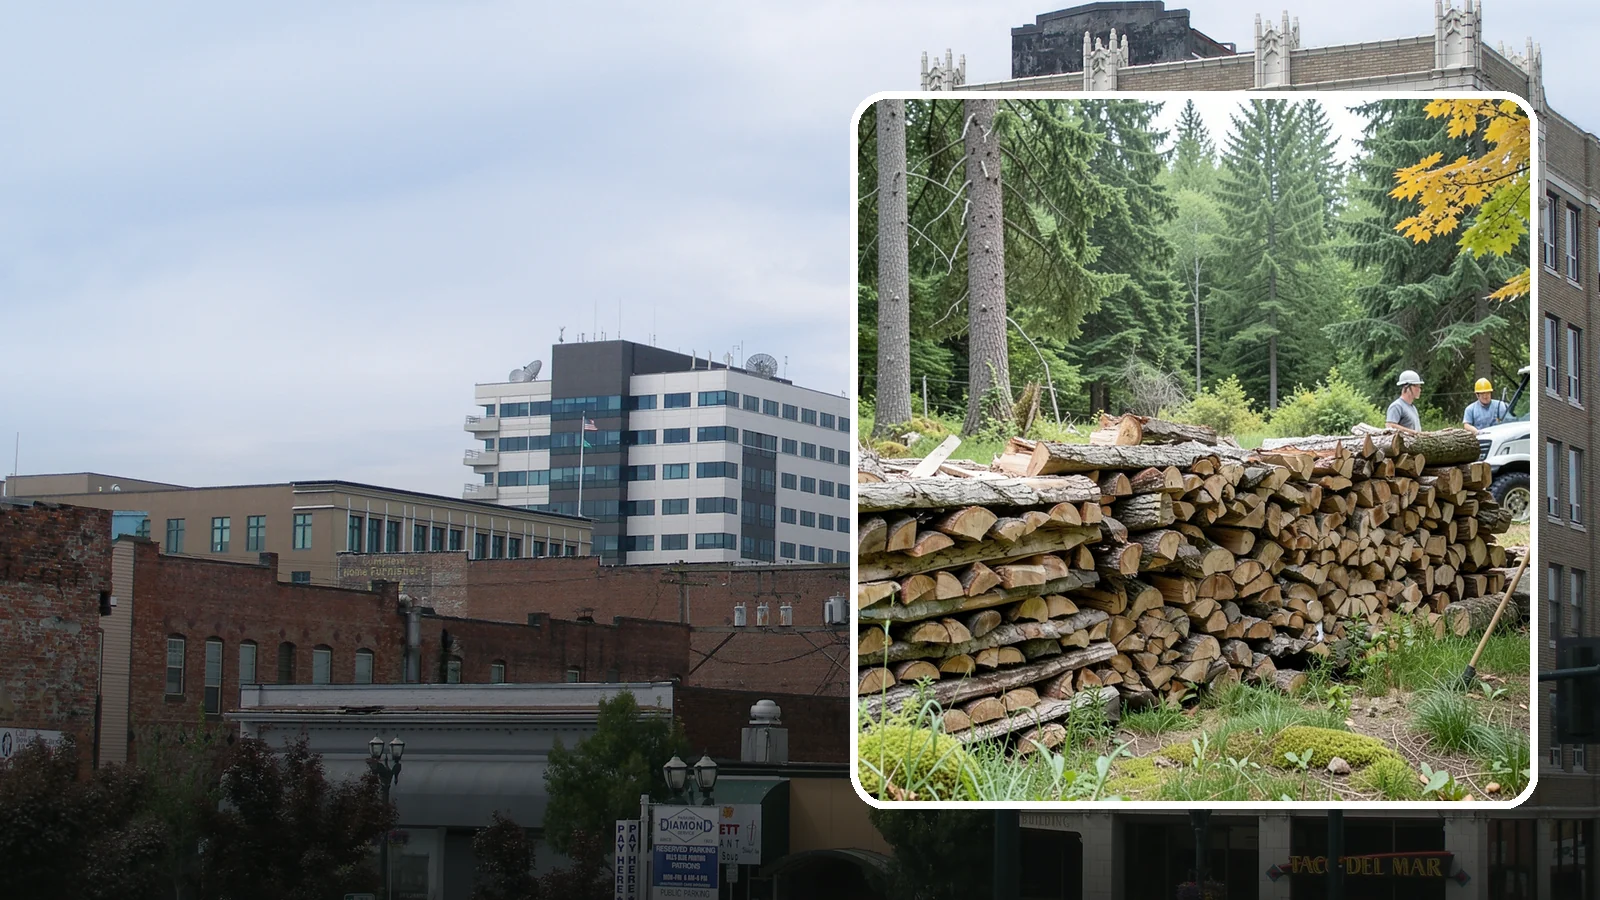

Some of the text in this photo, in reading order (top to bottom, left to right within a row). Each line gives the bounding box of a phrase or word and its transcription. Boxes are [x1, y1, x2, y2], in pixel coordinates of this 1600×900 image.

[343, 566, 427, 577] Home Furnishers
[660, 818, 713, 832] DIAMOND
[1022, 815, 1069, 828] BUILDING
[656, 845, 716, 854] RESERVED PARKING
[617, 825, 625, 893] PAY HERE
[627, 824, 636, 893] PAY HERE
[721, 851, 739, 861] Soup
[671, 862, 701, 870] PATRONS
[1346, 856, 1385, 875] DEL
[1392, 857, 1443, 877] MAR
[660, 888, 710, 898] PUBLIC PARKING
